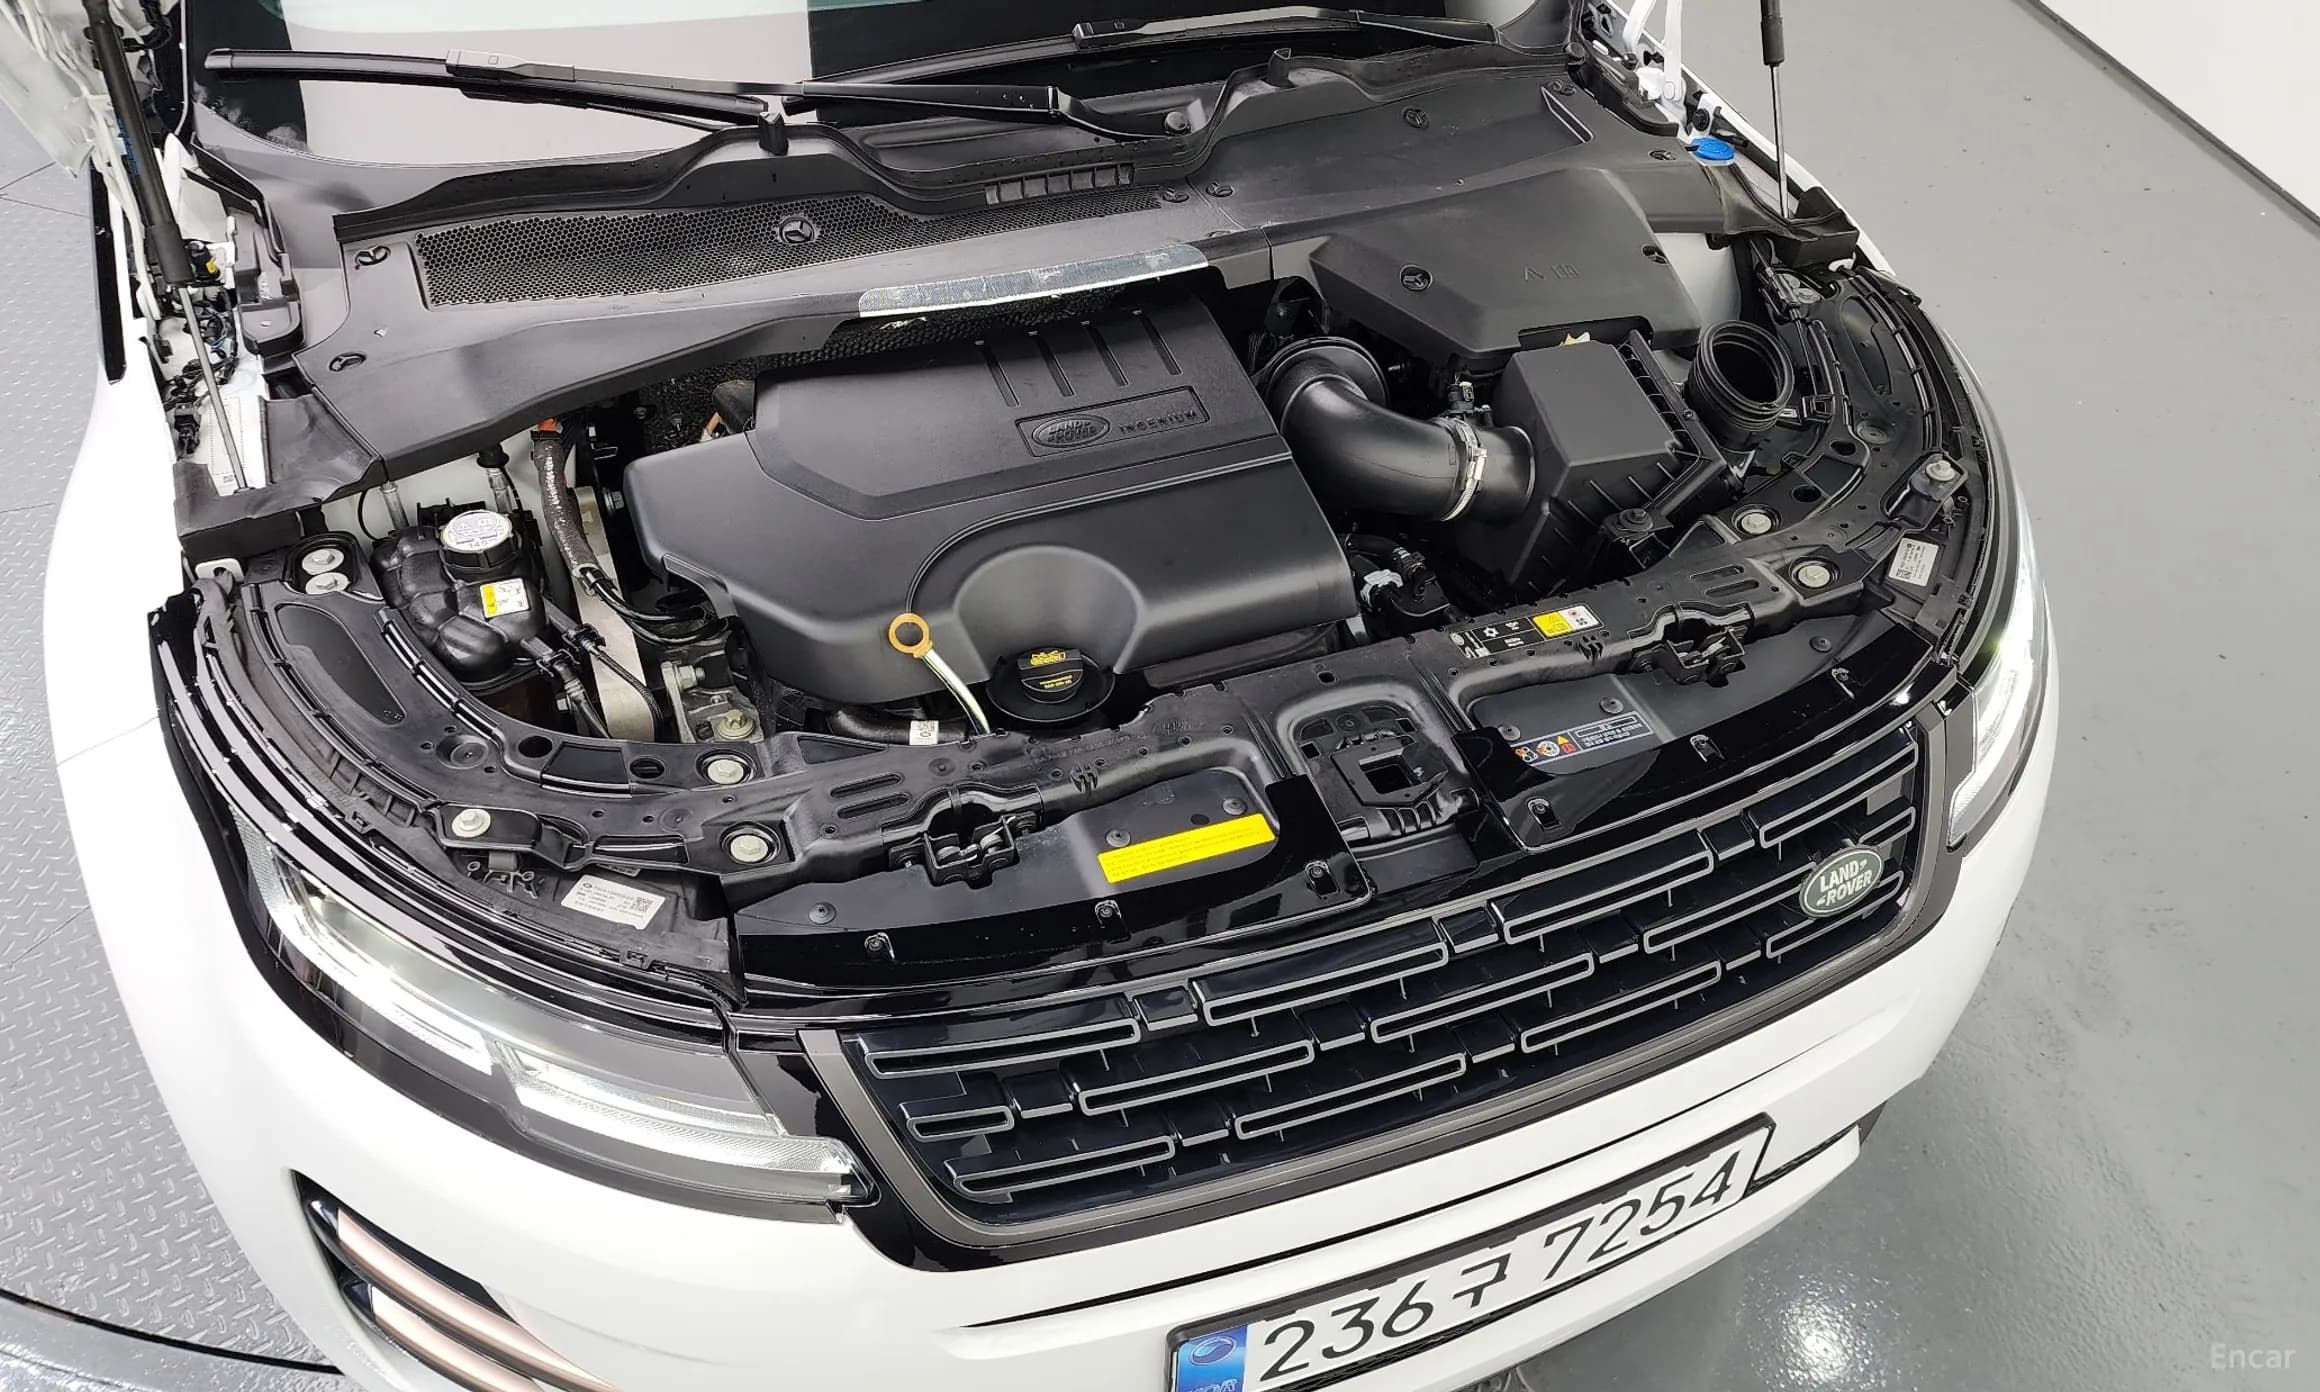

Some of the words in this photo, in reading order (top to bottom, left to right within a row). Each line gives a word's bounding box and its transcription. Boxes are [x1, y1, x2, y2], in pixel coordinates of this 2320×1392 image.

[1820, 860, 1860, 893] LAND
[1825, 869, 1873, 906] ROVER
[1259, 1252, 1512, 1382] 236구
[1543, 1151, 1741, 1283] 7254
